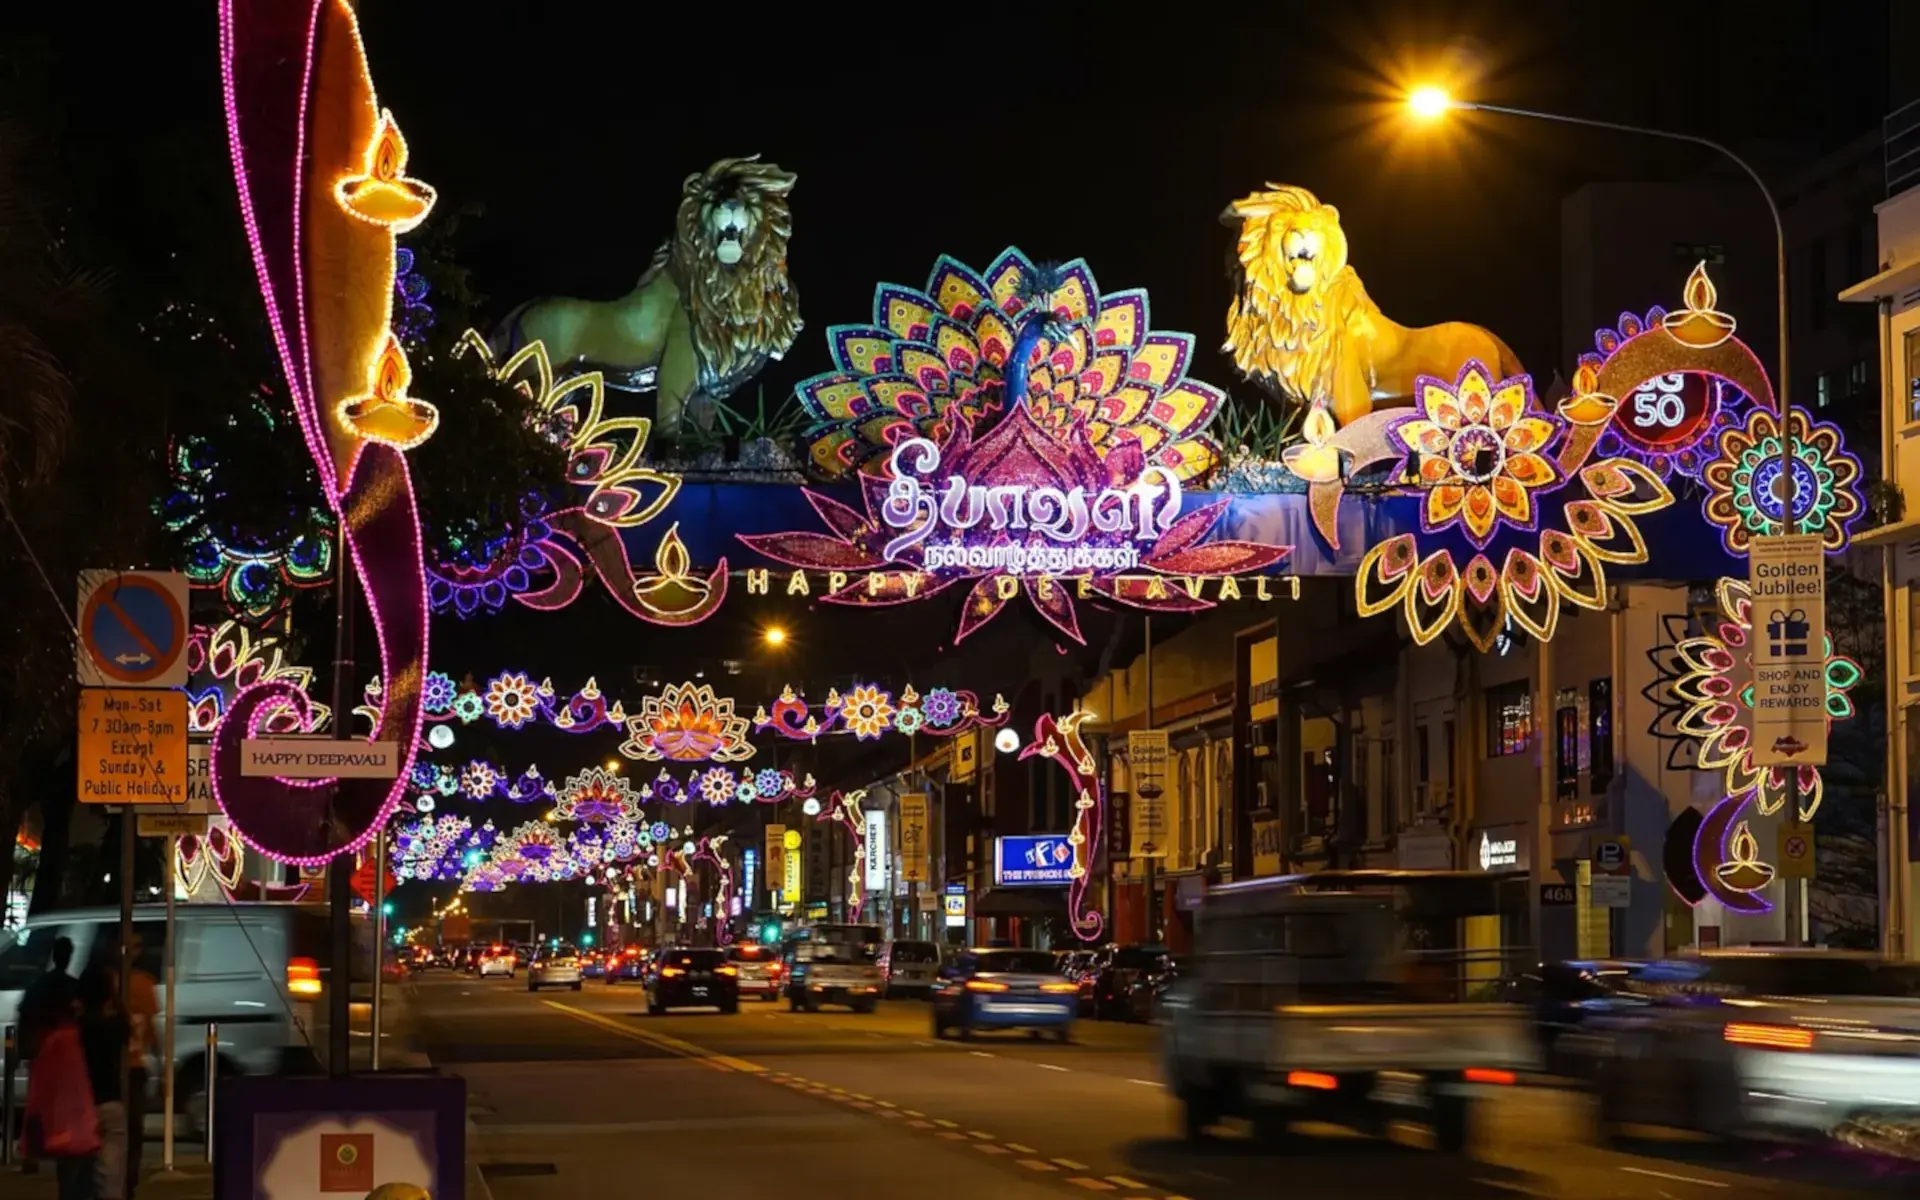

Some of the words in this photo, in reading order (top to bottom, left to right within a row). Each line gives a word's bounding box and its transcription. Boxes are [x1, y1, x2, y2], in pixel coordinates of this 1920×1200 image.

[1634, 393, 1685, 427] 50
[1756, 562, 1818, 578] Golden
[747, 568, 924, 597] HAPPY
[995, 573, 1301, 601] DEEAVALI
[1754, 579, 1822, 596] Jubilee!
[1758, 670, 1790, 682] SHOP
[1794, 669, 1820, 680] AND
[1770, 684, 1808, 695] ENJOY
[104, 698, 162, 712] Mon-Sat
[1760, 697, 1820, 708] REWARDS
[111, 740, 154, 758] Except
[99, 758, 146, 777] Sunday
[155, 760, 166, 775] &
[252, 753, 302, 765] HAPPY
[306, 753, 387, 766] DEEPAVALI
[84, 780, 122, 796] Public
[126, 780, 181, 798] Holidays
[1544, 887, 1573, 901] 468
